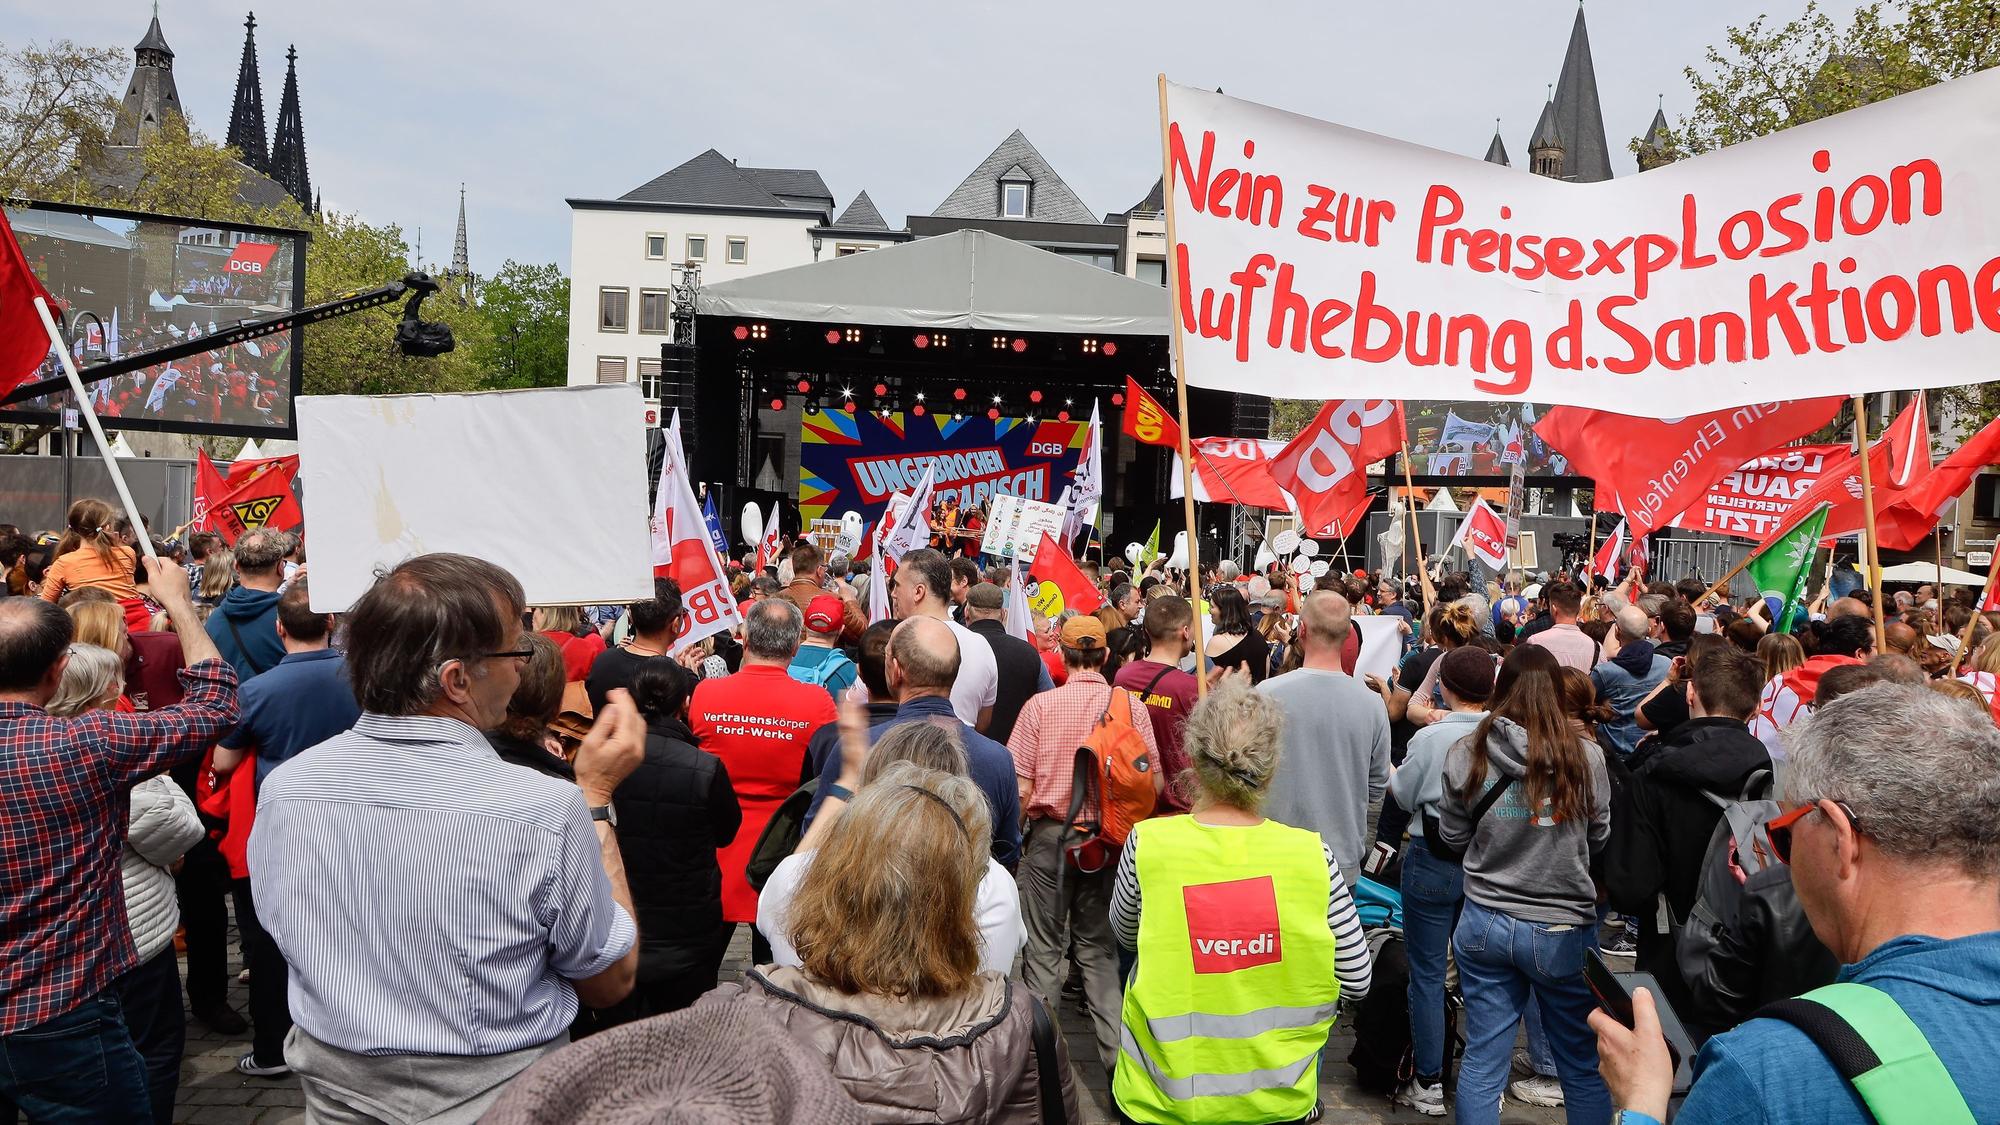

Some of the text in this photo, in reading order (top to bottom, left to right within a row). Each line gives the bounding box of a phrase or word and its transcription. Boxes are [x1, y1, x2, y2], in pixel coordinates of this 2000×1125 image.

[1169, 121, 1283, 228] Nein
[1297, 184, 1396, 247] zur
[231, 260, 262, 273] DGB
[1031, 442, 1063, 455] DGB
[854, 450, 1004, 496] UNGEBROCHEN
[703, 712, 810, 730] Vertrauenskörper
[716, 725, 793, 740] Ford-Werke
[1196, 933, 1274, 956] ver.di
